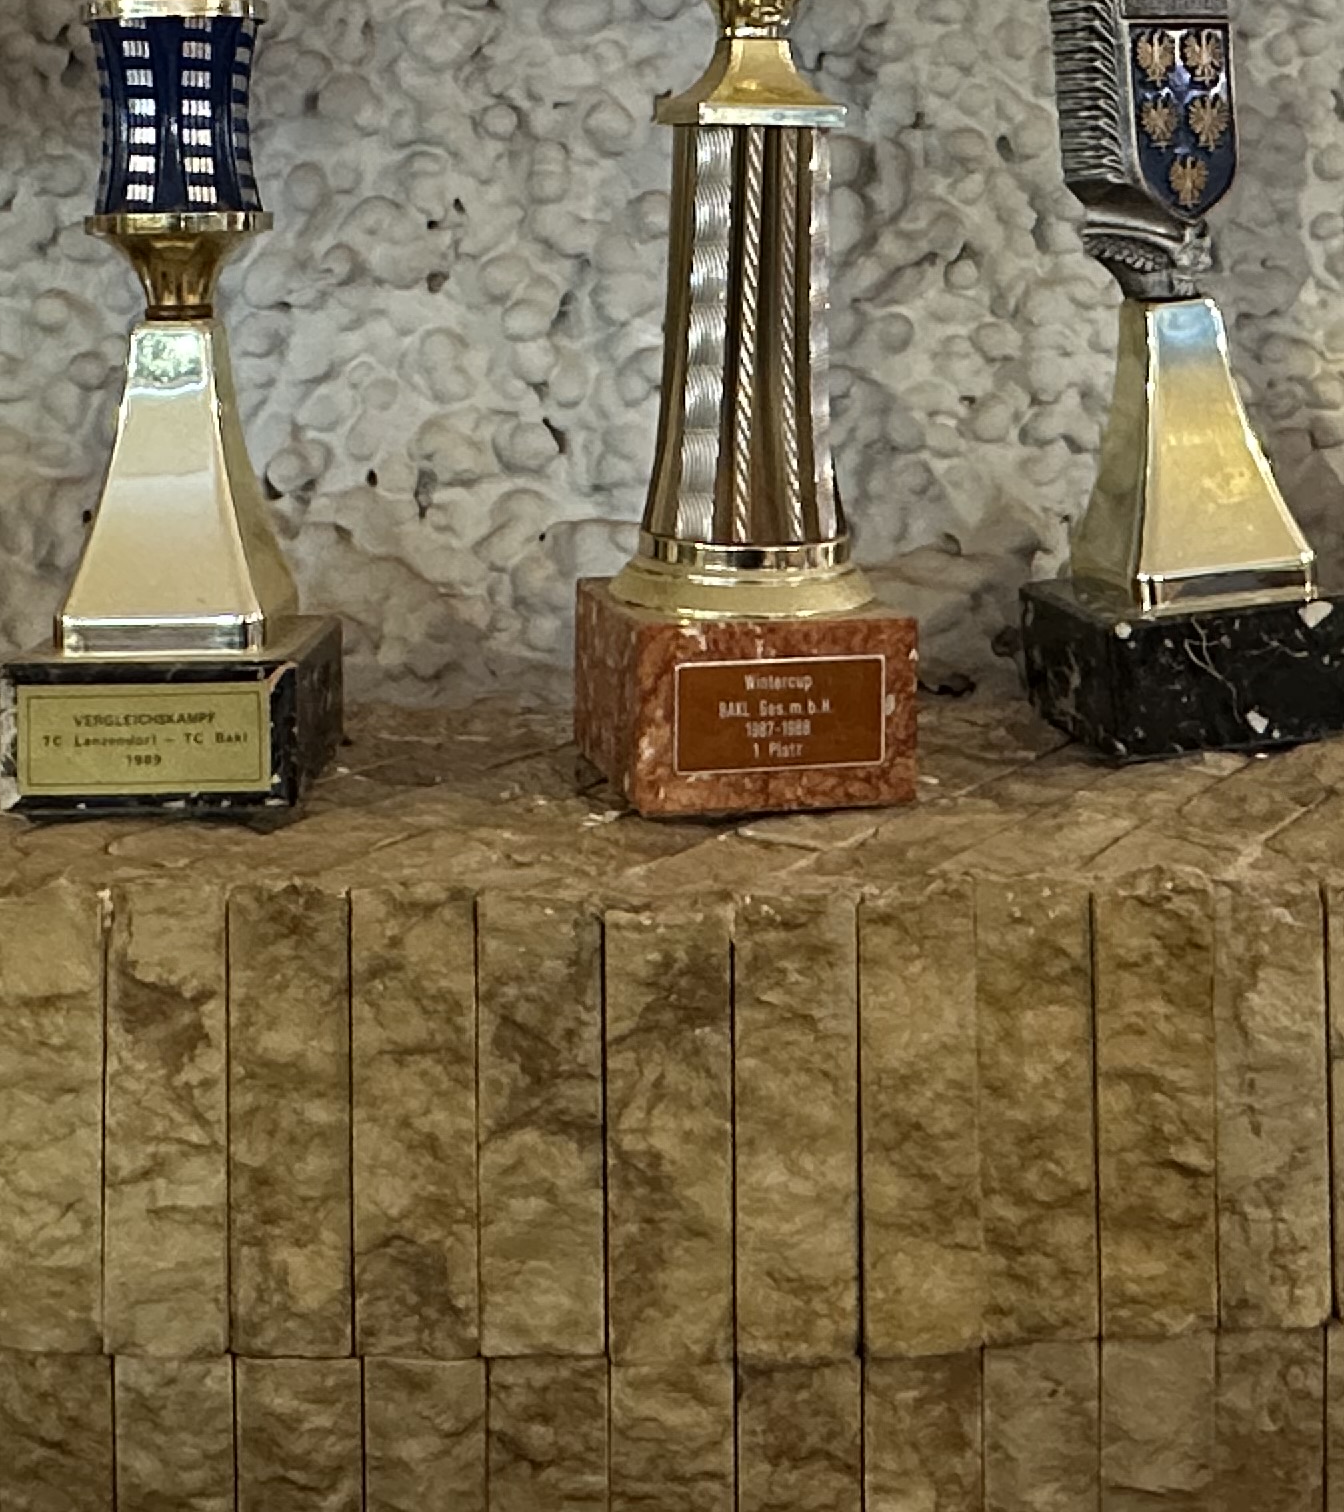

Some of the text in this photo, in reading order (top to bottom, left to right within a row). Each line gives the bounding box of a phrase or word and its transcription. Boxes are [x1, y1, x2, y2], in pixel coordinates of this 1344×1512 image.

[744, 674, 814, 692] Wintercup
[73, 710, 216, 727] VERGLEICHSKAMPF
[719, 700, 751, 720] BAKL
[42, 734, 63, 747] TC
[184, 732, 204, 745] TC
